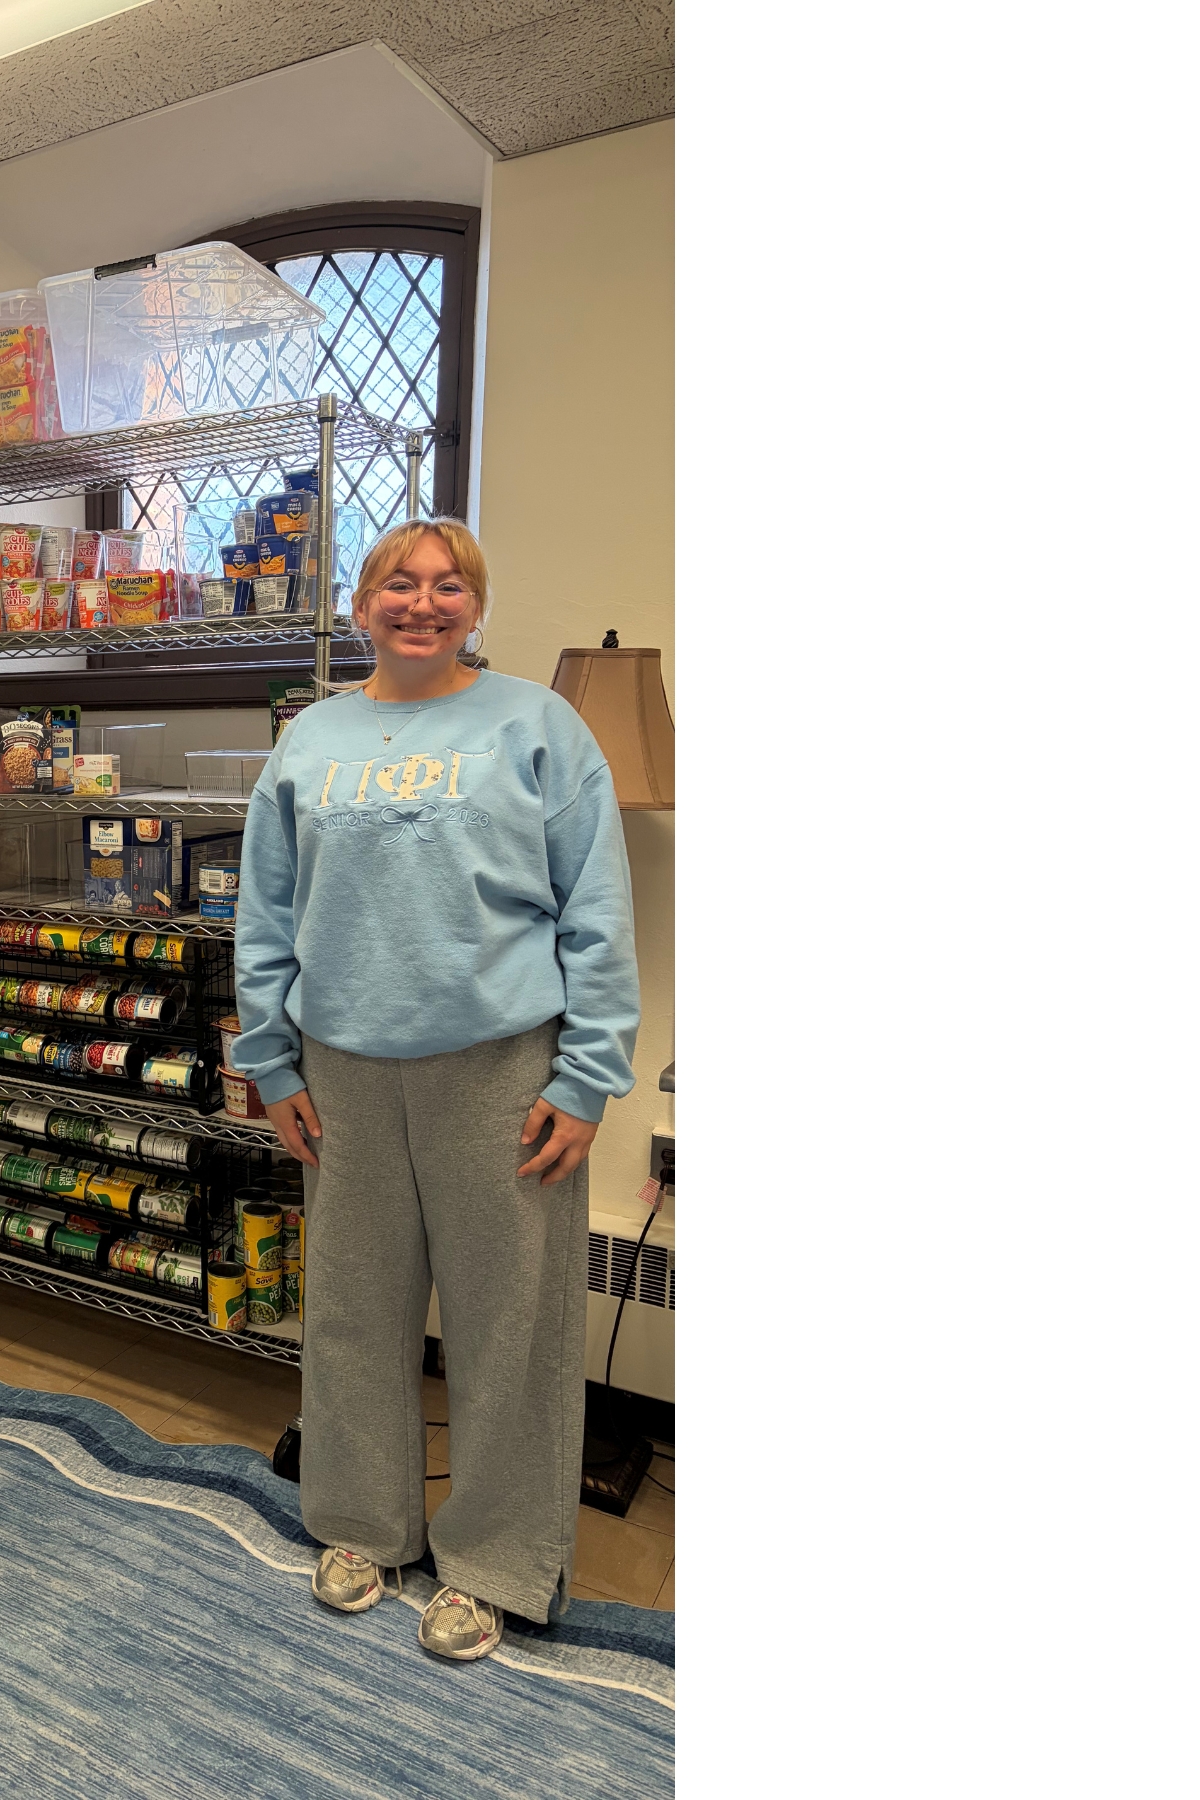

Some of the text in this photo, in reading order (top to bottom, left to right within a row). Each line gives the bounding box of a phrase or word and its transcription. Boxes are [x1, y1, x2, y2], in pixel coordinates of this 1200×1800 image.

[10, 535, 30, 544] CUP
[3, 542, 36, 552] NOODLES
[117, 576, 153, 585] Maruchan
[123, 601, 144, 609] Chicken
[277, 707, 303, 716] MINES
[312, 808, 490, 833] SENIOR 2026
[255, 1277, 273, 1285] Save
